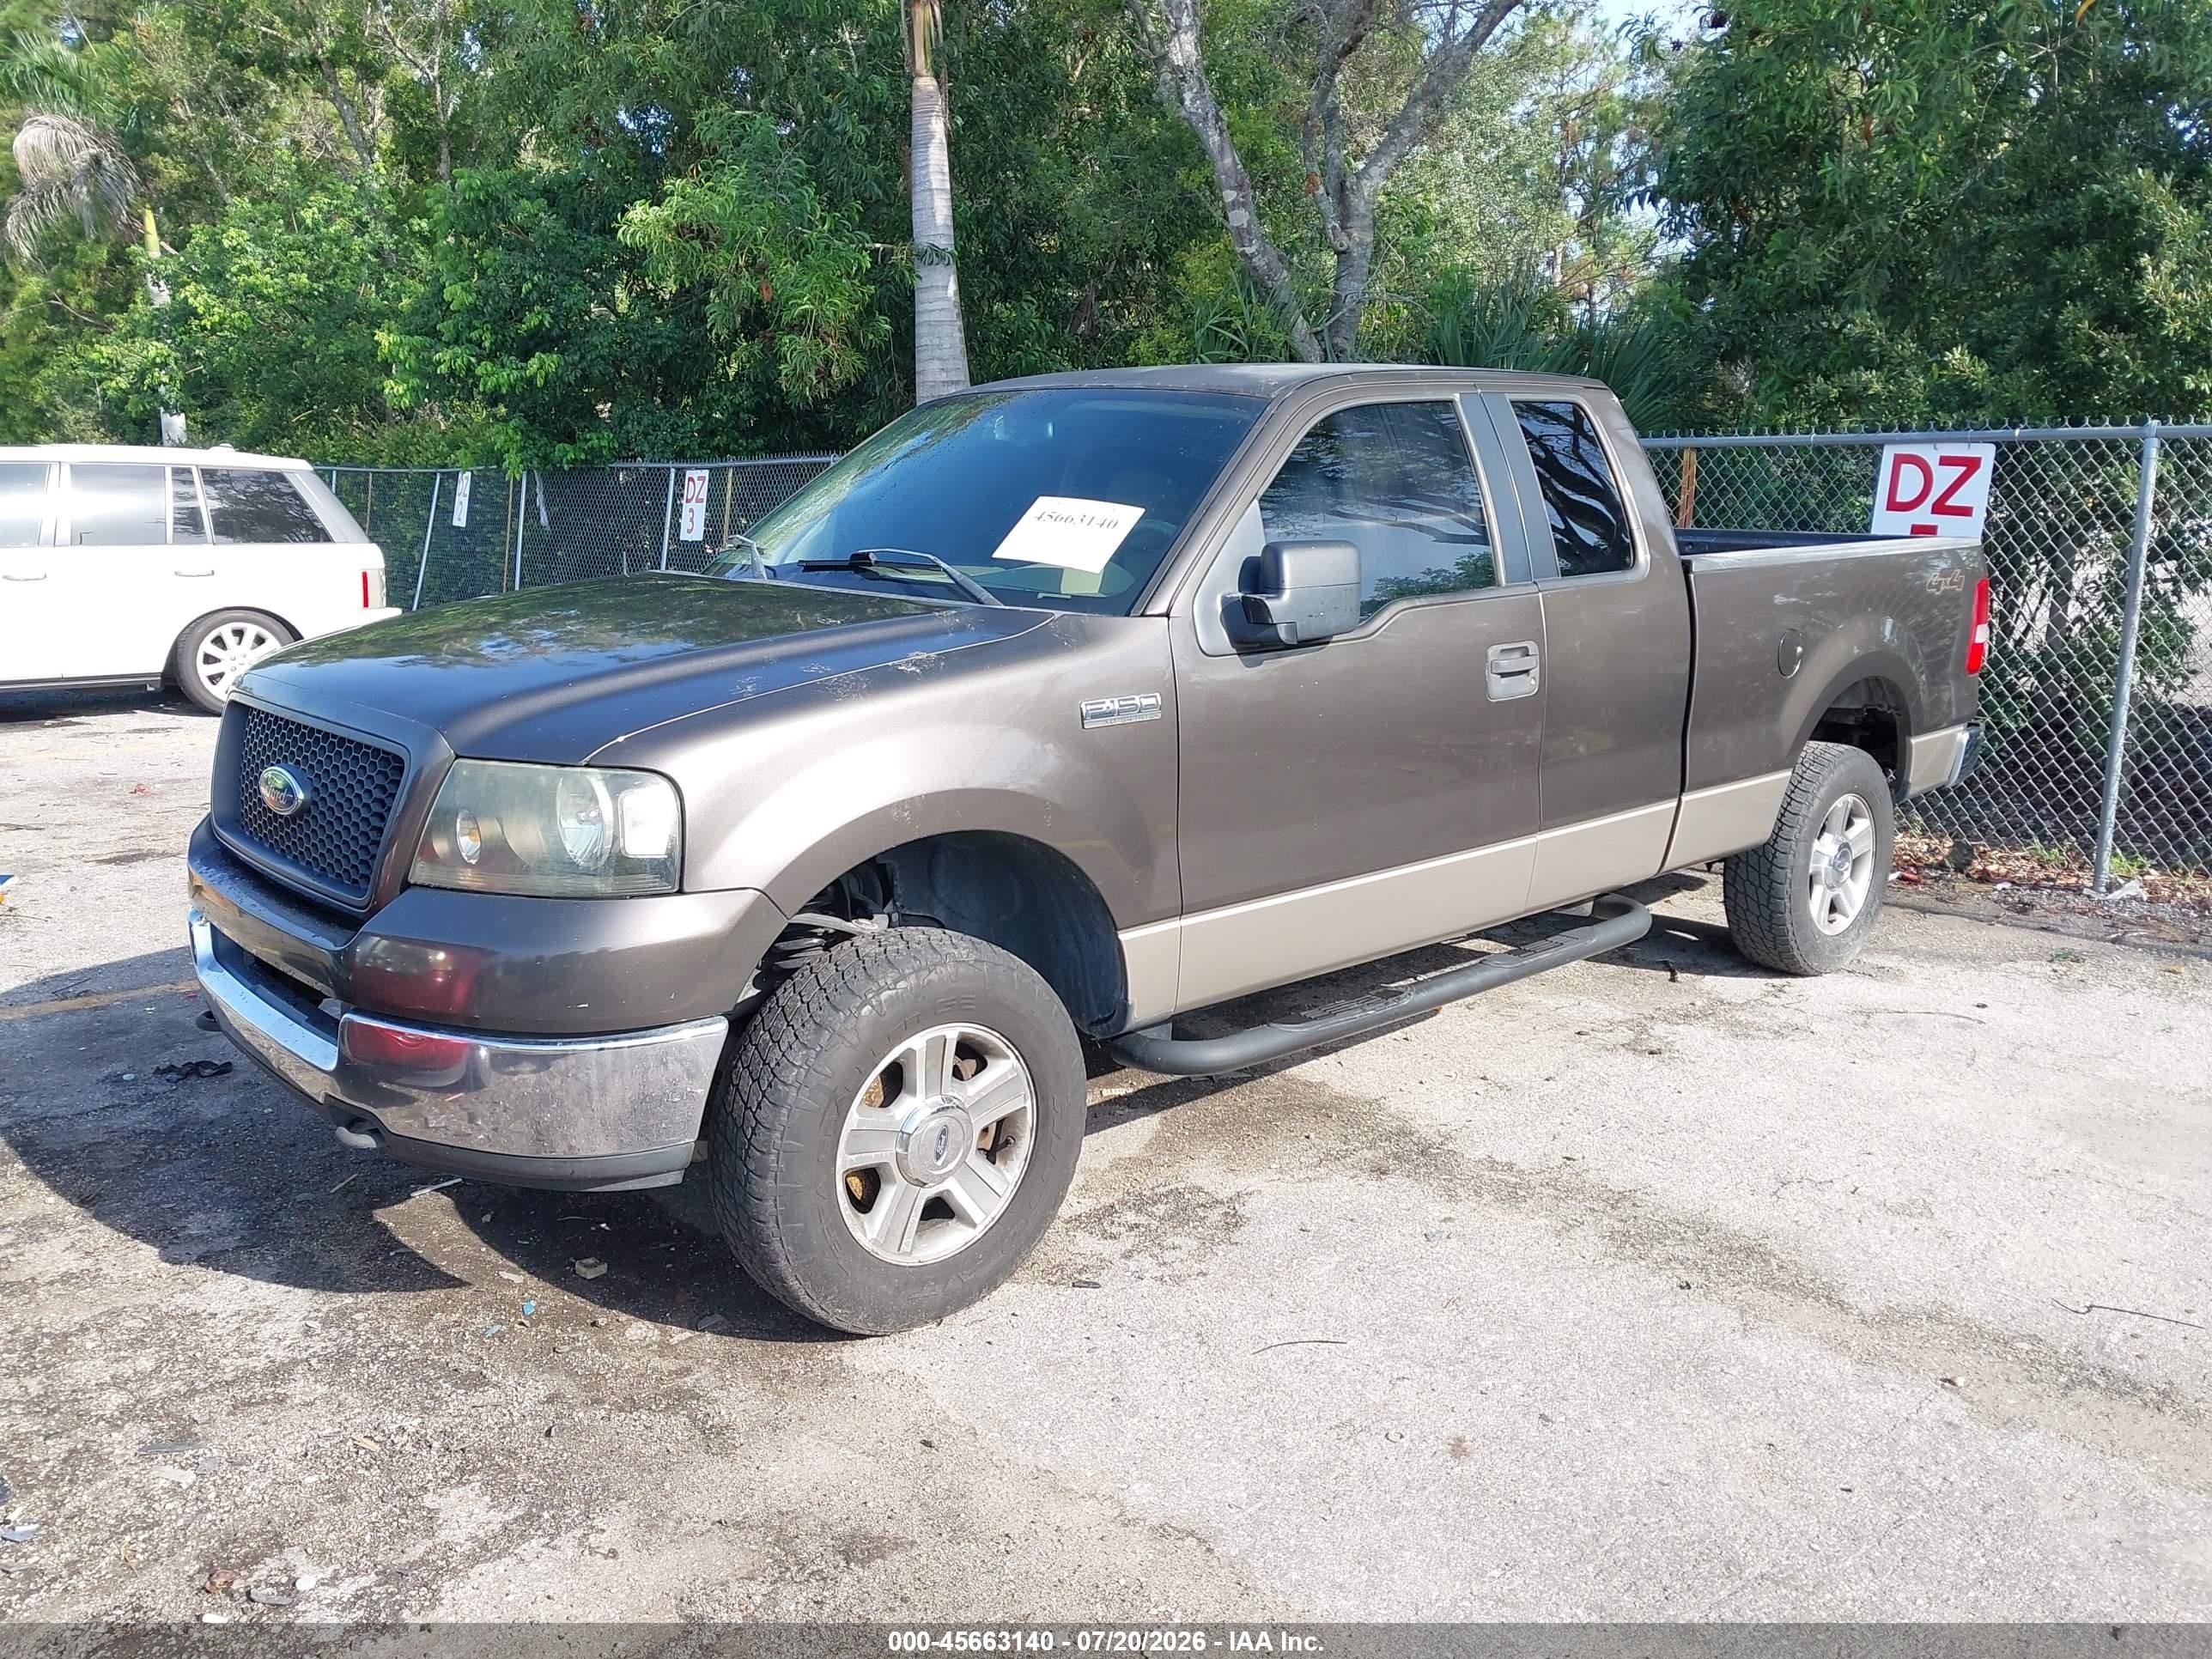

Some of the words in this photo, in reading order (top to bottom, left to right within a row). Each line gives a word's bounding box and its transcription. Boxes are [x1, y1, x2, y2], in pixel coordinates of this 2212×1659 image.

[685, 476, 706, 504] DZ
[1886, 453, 1982, 518] DZ
[458, 501, 463, 522] 2
[686, 507, 695, 534] 3
[1034, 511, 1119, 530] 45663140
[263, 774, 294, 805] Ford
